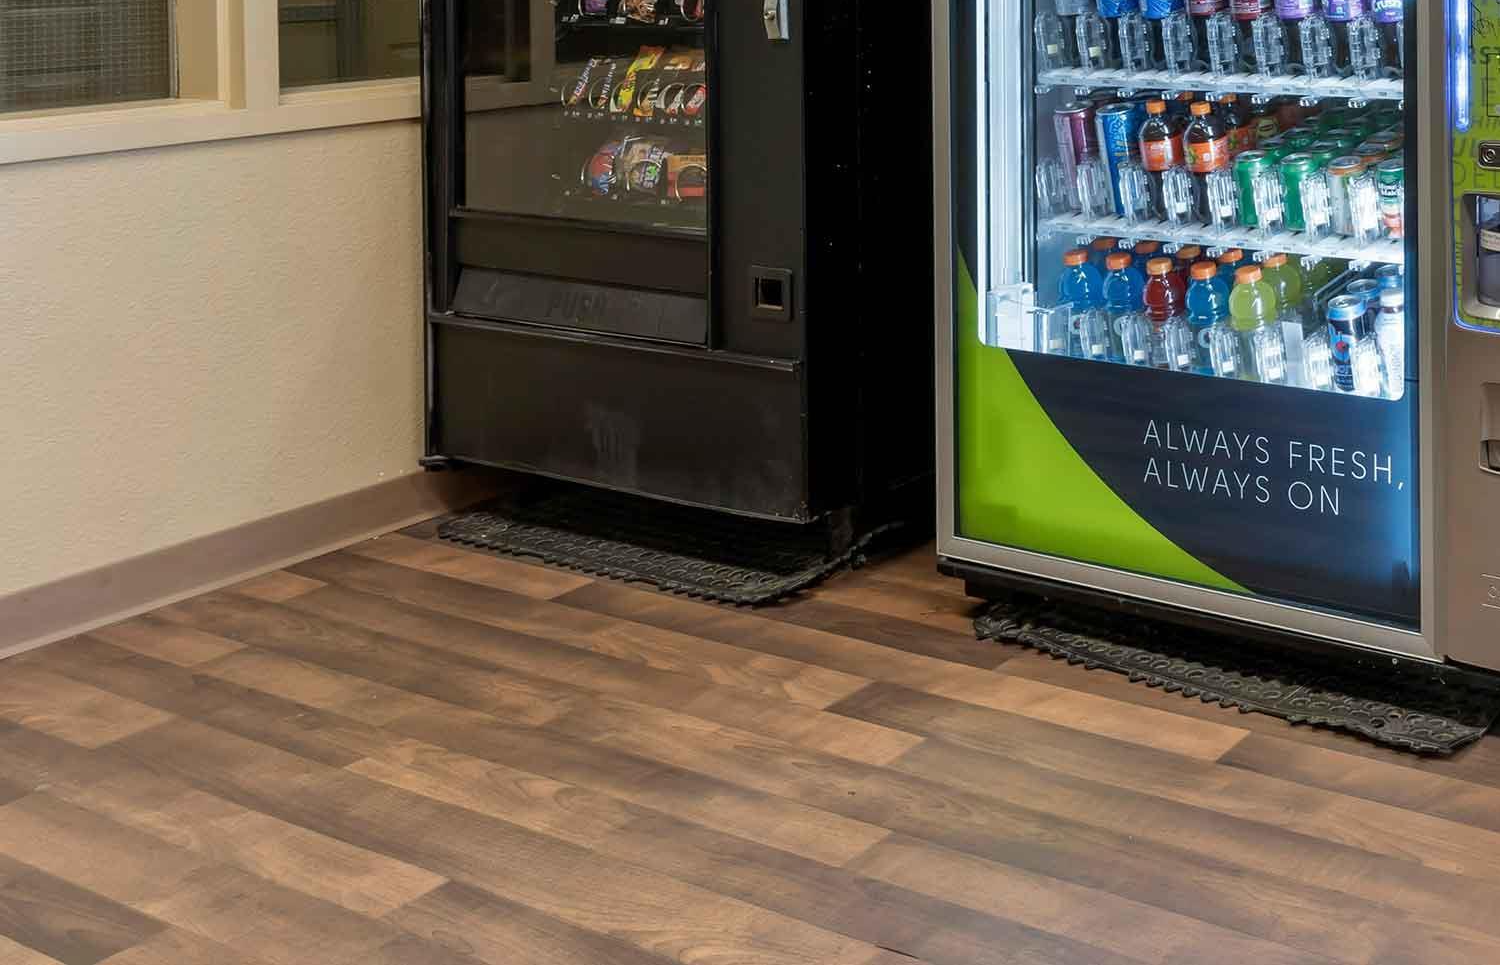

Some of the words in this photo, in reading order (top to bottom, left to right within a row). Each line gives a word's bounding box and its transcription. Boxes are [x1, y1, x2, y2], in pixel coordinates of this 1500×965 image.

[1143, 419, 1270, 464] ALWAYS
[1289, 440, 1404, 490] FRESH,
[1143, 457, 1270, 503] ALWAYS
[1288, 481, 1340, 516] ON
